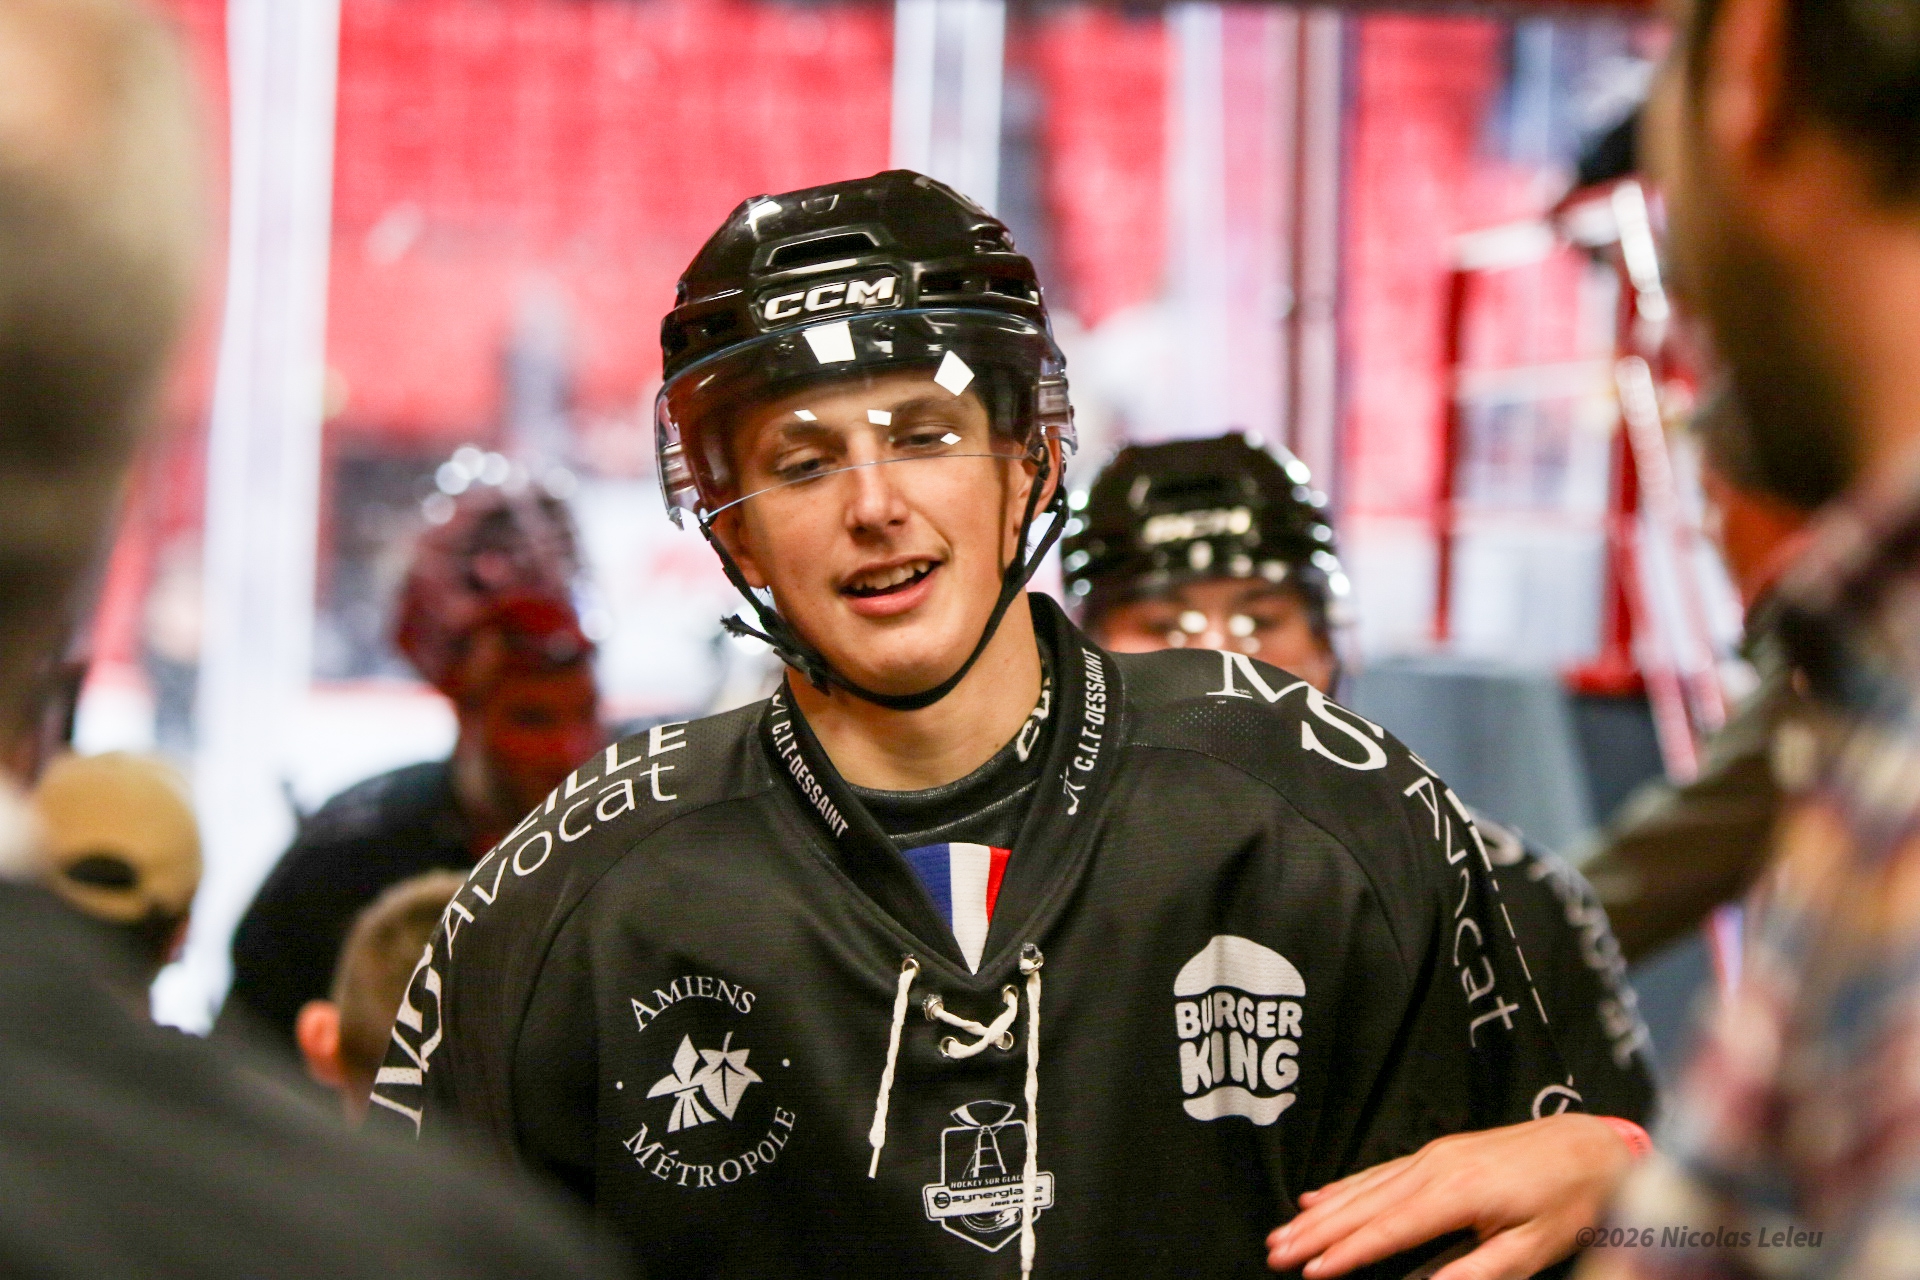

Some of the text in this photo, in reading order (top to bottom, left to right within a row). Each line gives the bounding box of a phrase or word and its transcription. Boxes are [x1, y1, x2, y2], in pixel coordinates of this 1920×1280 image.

[764, 276, 897, 321] CCM
[444, 762, 678, 960] Avocat
[630, 976, 756, 1032] AMIENS
[1175, 991, 1303, 1039] BURGER
[1180, 1031, 1301, 1095] KING
[622, 1106, 796, 1188] MÉTROPOLE
[950, 1174, 1025, 1189] HOCKEY SUR GLAC
[951, 1185, 1044, 1203] synerglae
